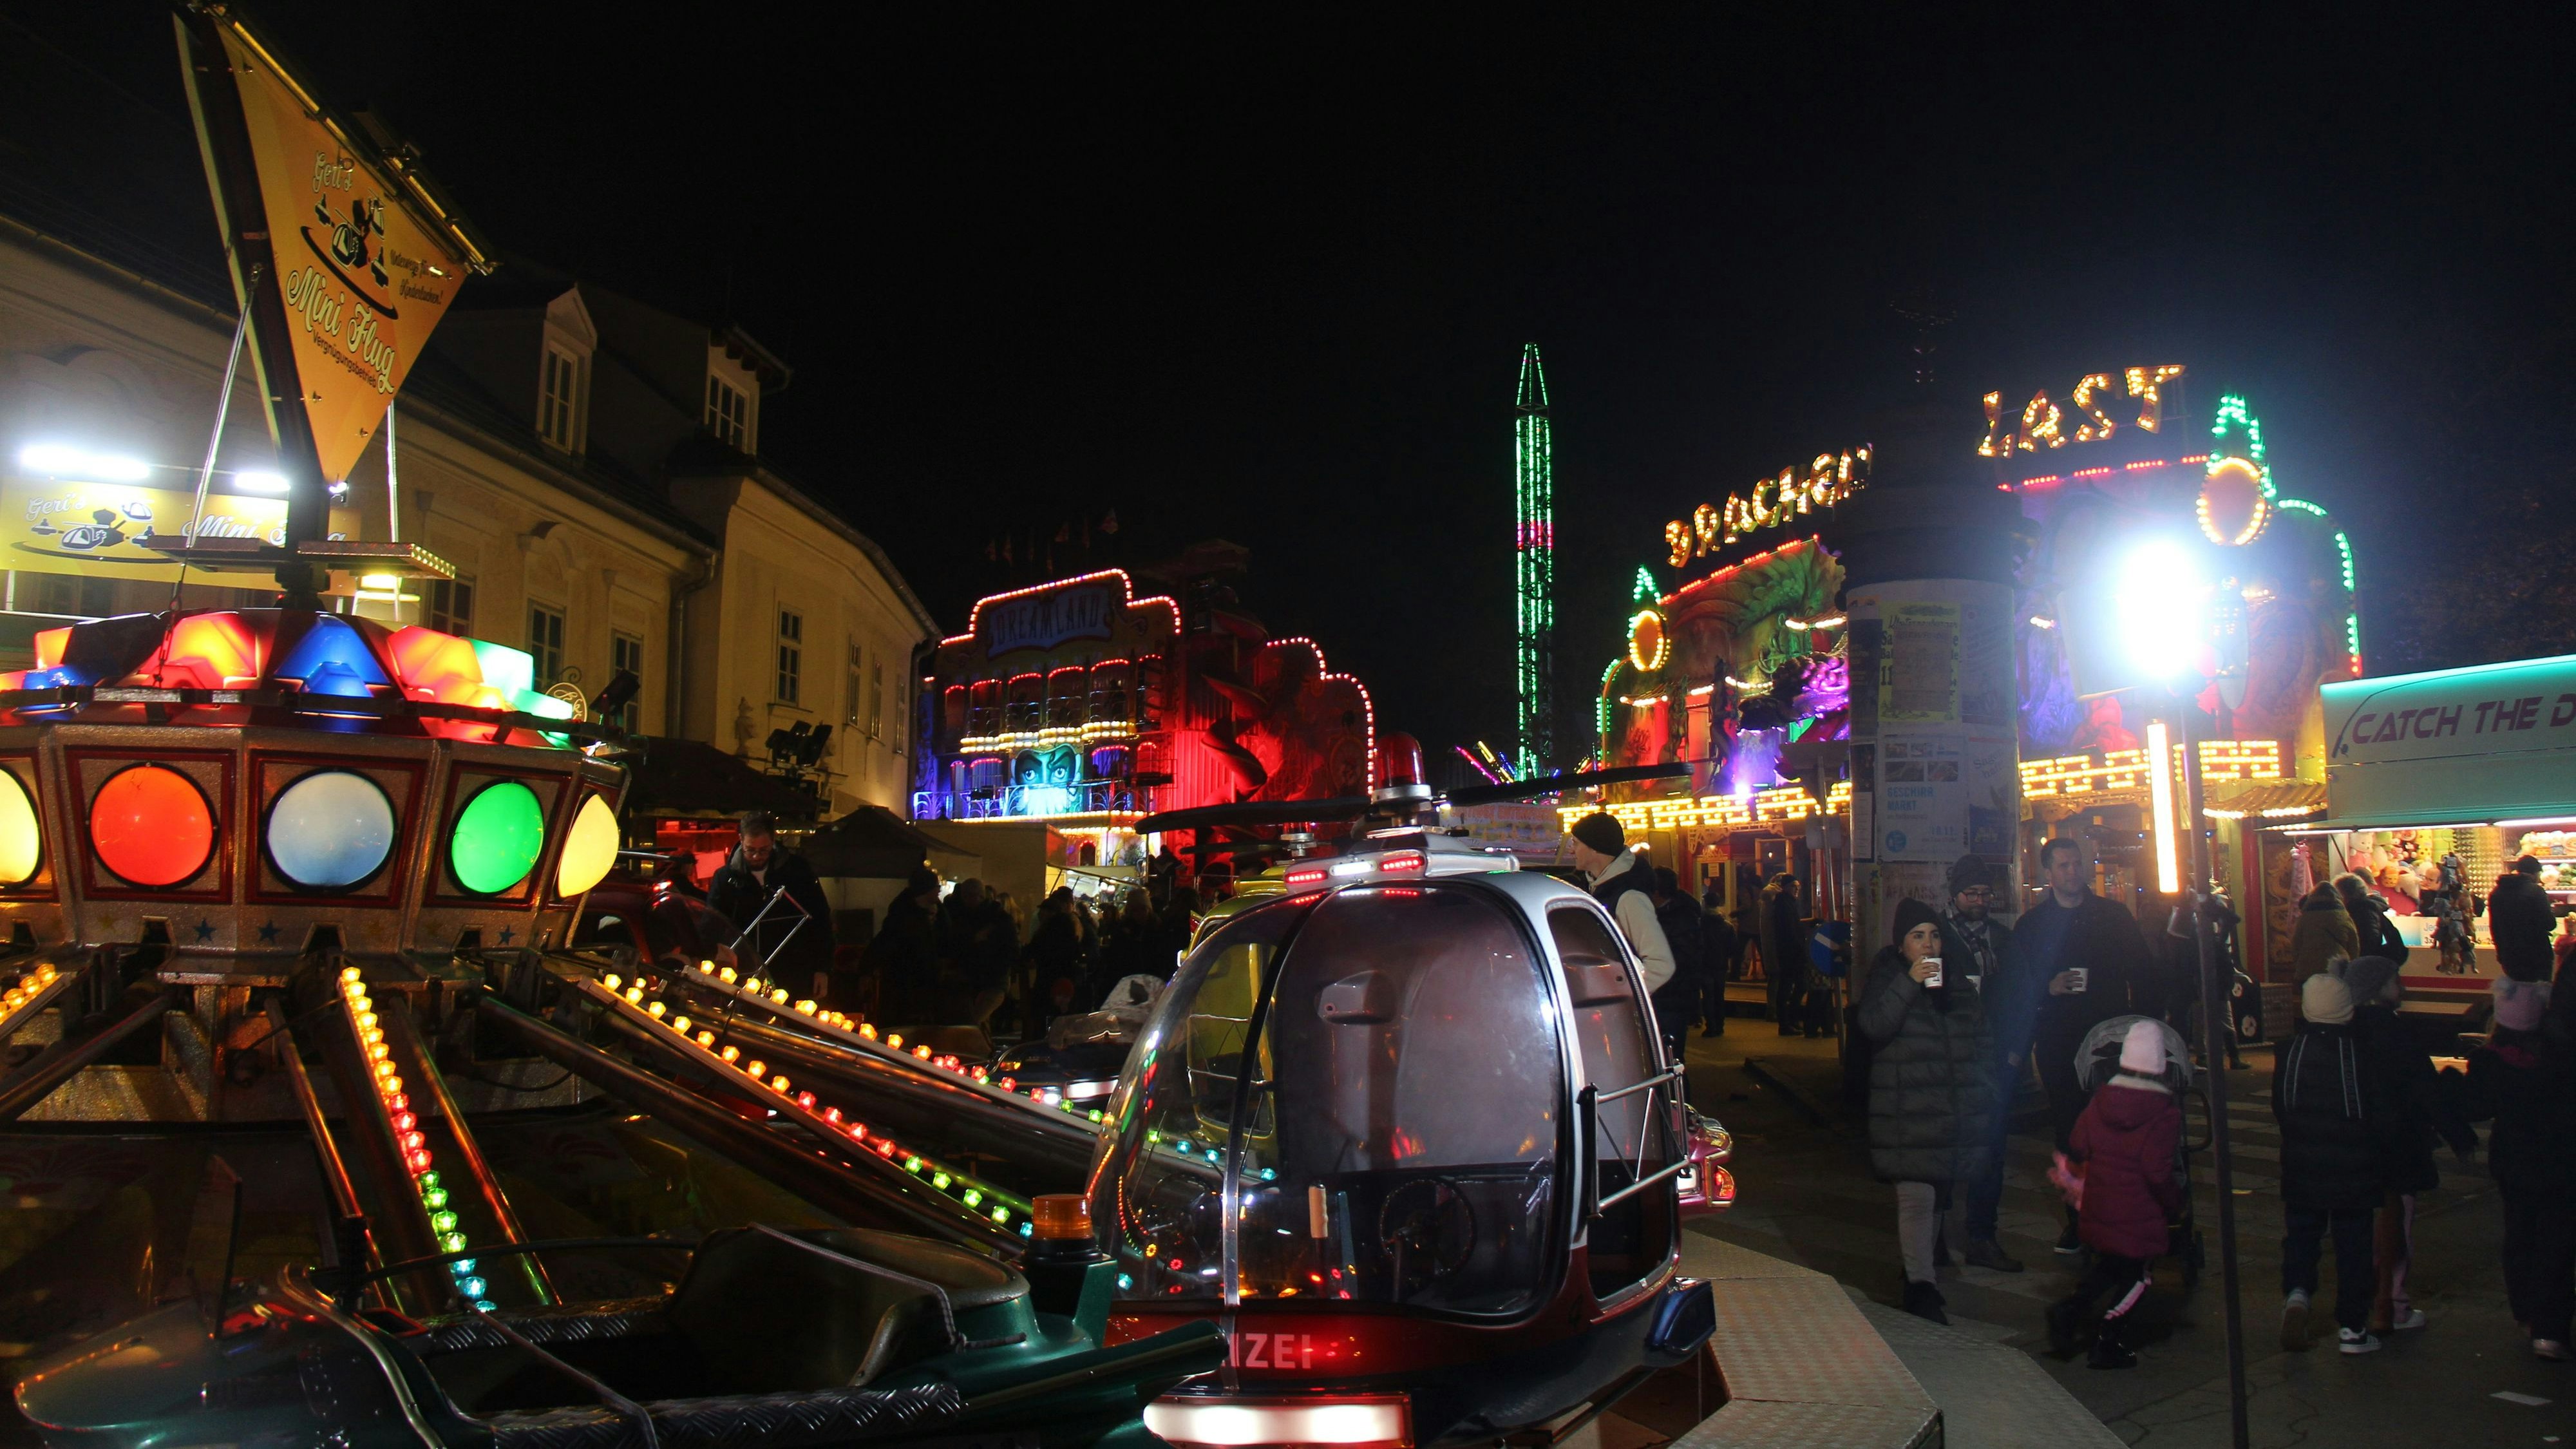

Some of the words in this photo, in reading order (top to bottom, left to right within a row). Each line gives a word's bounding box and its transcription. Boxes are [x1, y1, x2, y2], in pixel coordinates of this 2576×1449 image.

[287, 265, 346, 338] Mini
[347, 301, 395, 395] Flug
[313, 330, 377, 388] Vergnügungsbetrieb
[996, 594, 1100, 646] DREAMLAND
[2352, 705, 2463, 744] CATCH
[2475, 696, 2544, 734] THE
[1227, 1332, 1312, 1370] IZEI
